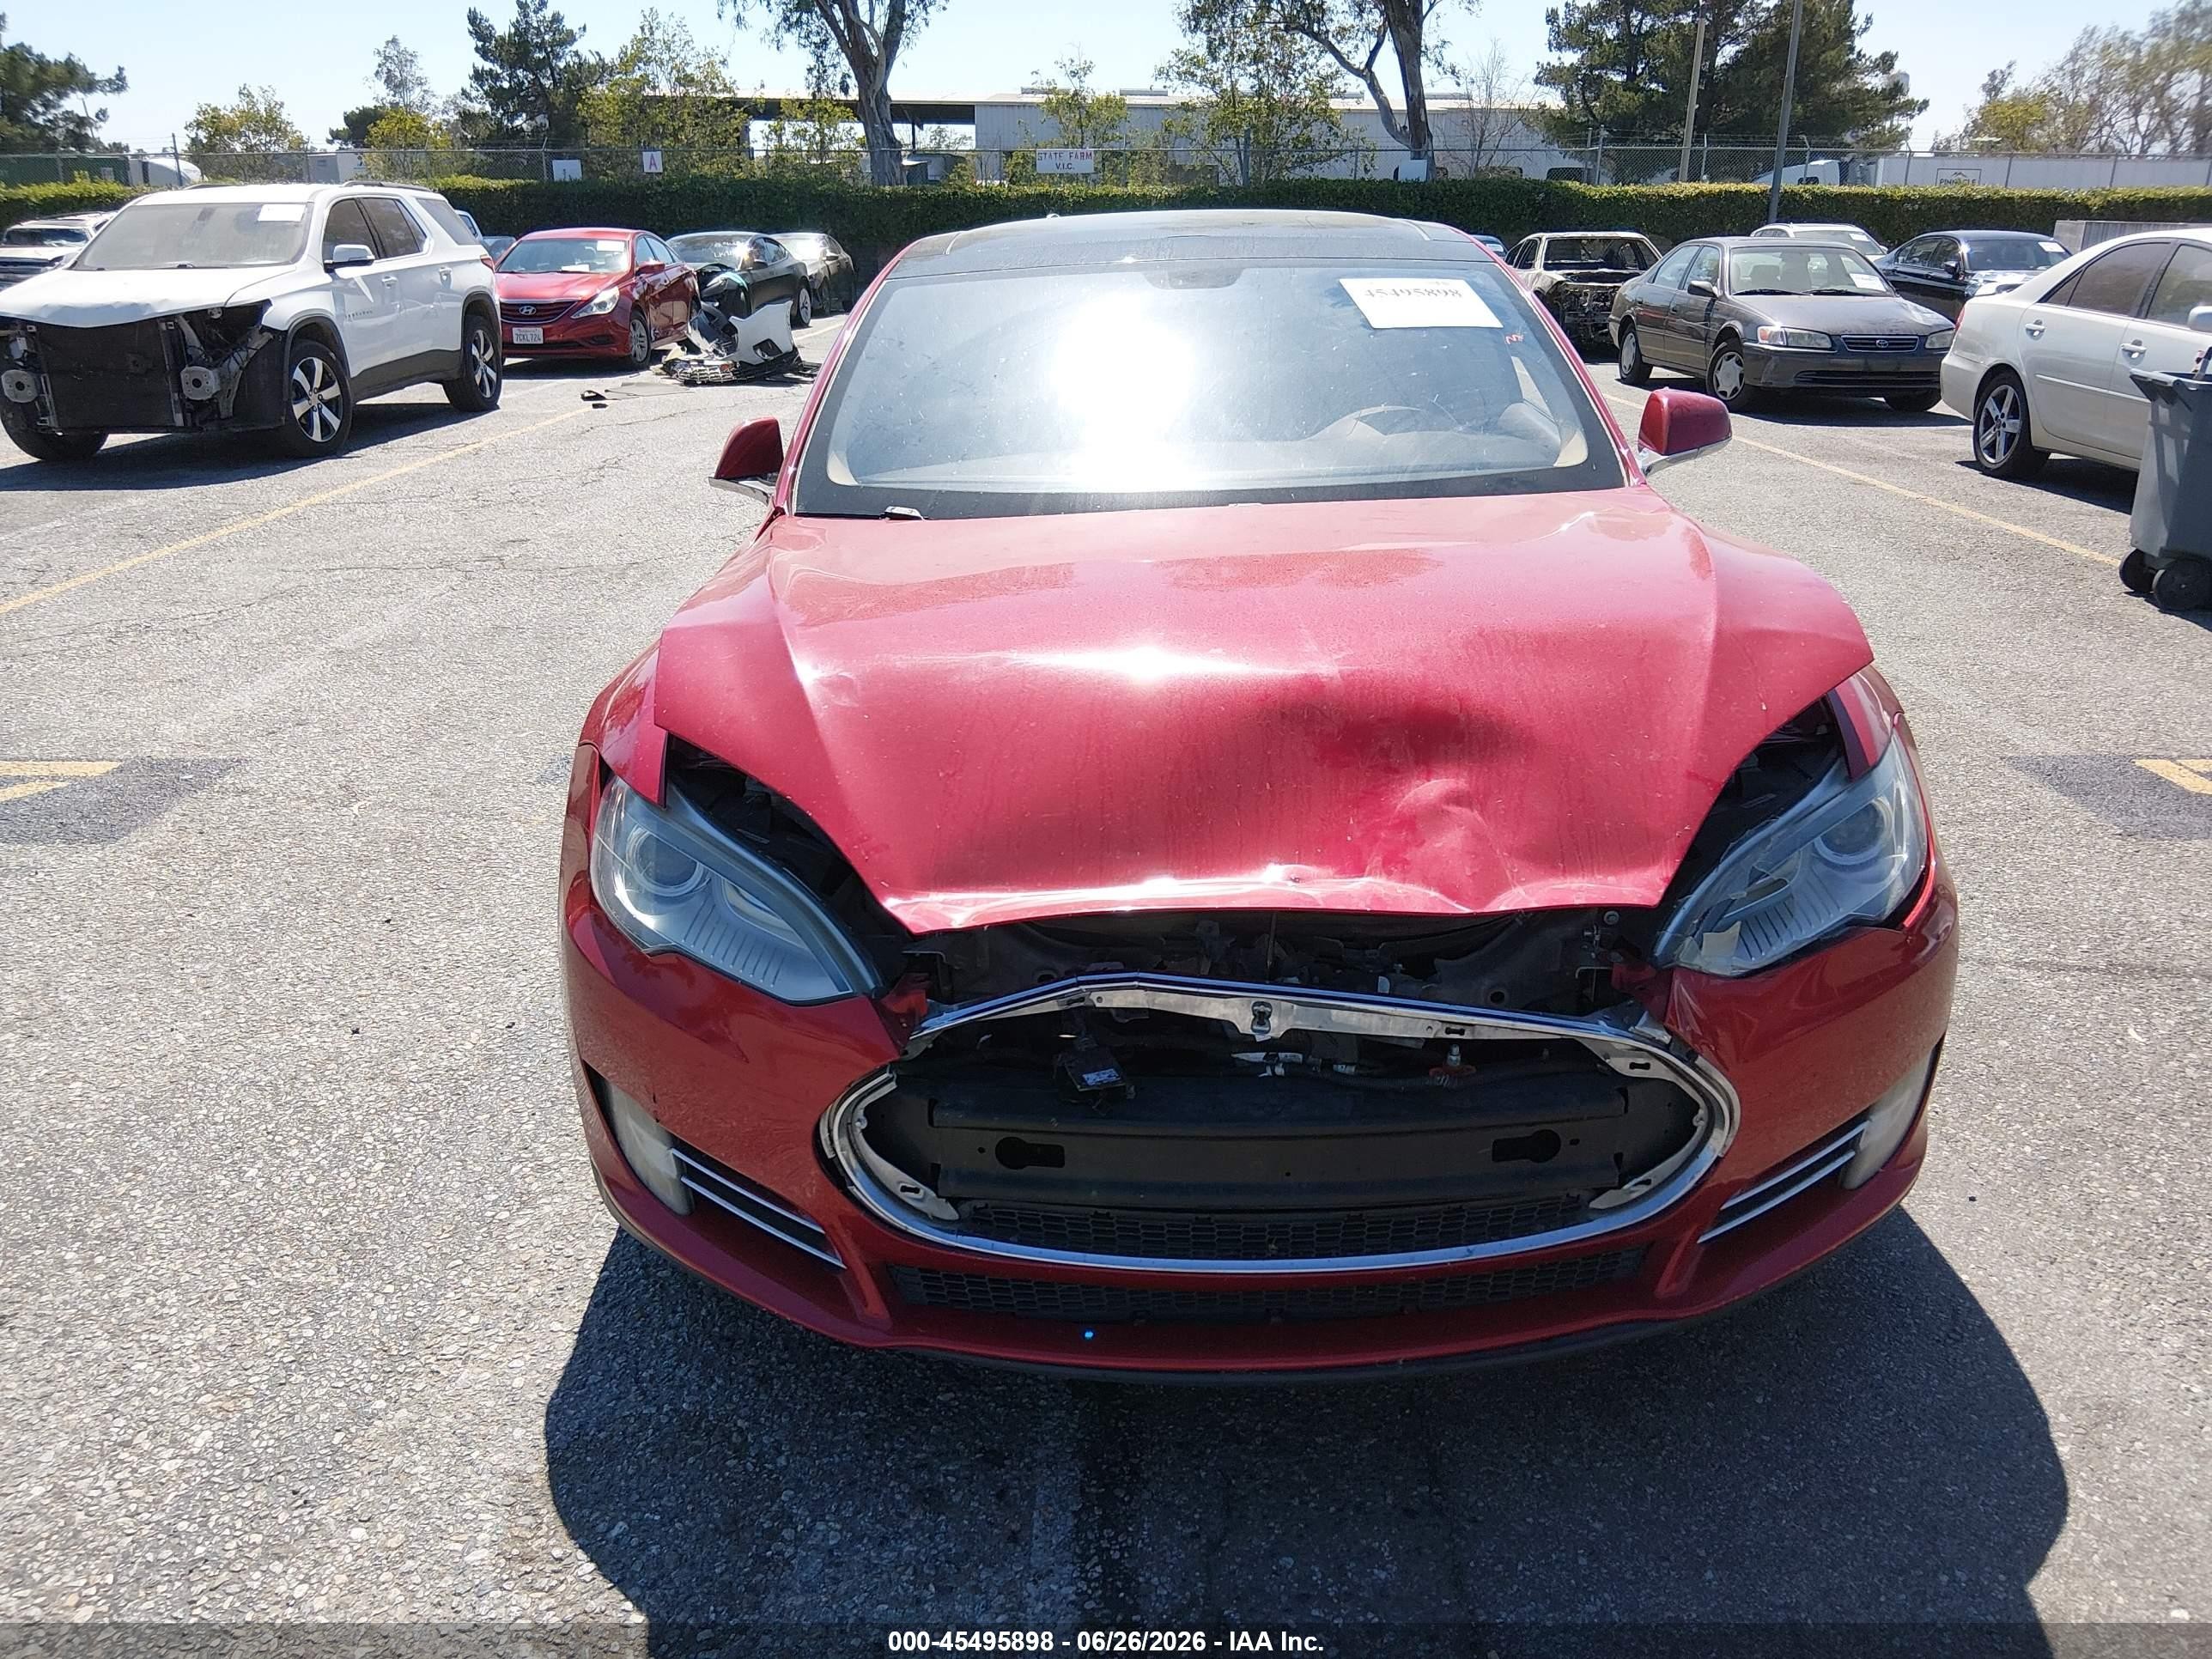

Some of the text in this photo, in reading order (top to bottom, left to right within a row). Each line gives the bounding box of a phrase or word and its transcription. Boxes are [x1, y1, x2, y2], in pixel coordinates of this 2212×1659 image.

[649, 153, 658, 170] A
[1037, 152, 1092, 161] STATE FARM
